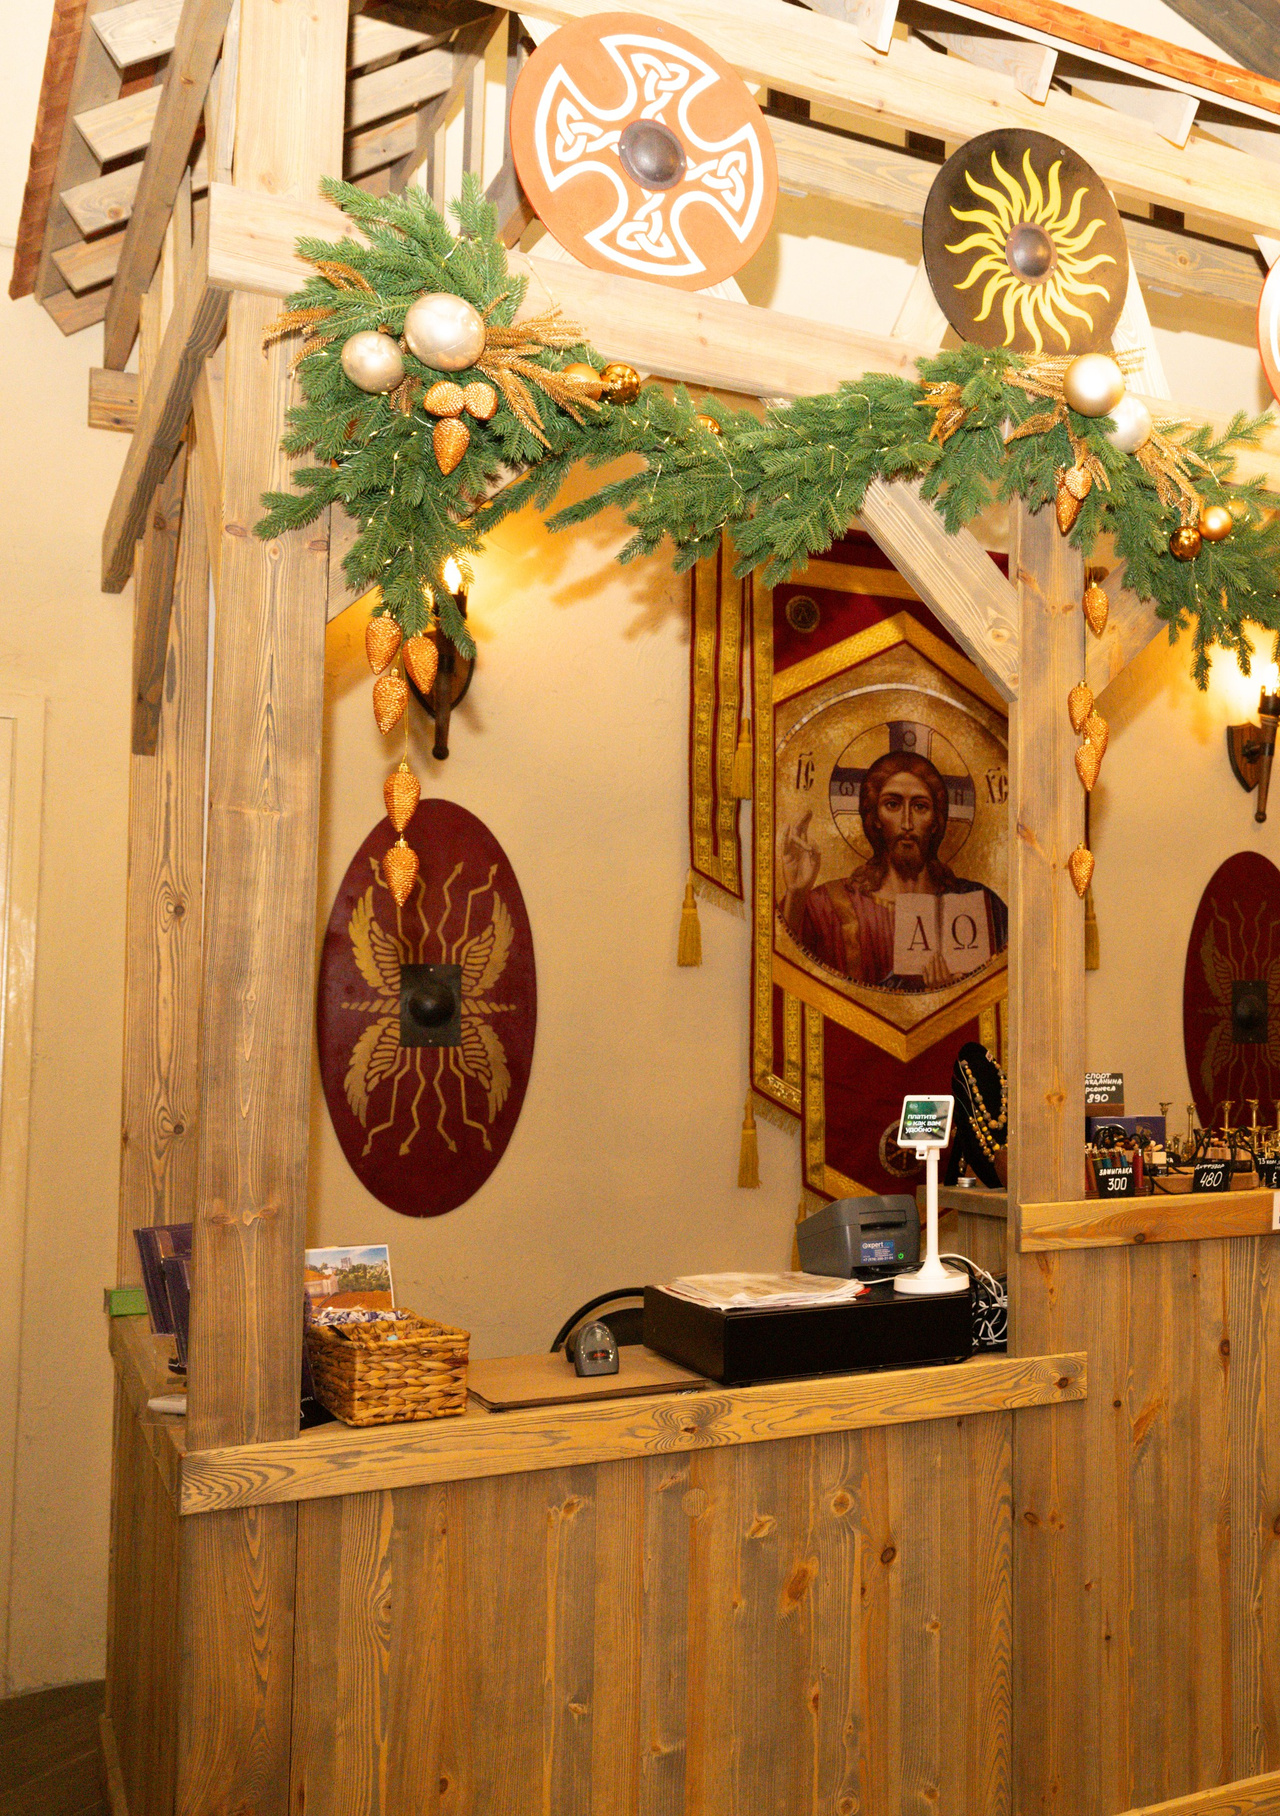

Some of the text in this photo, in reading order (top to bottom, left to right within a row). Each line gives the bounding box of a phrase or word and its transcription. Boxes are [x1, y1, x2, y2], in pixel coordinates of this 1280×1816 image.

[1087, 1093, 1109, 1104] 890
[905, 1126, 932, 1134] удобно
[1107, 1176, 1128, 1191] 300
[1199, 1171, 1223, 1187] 480
